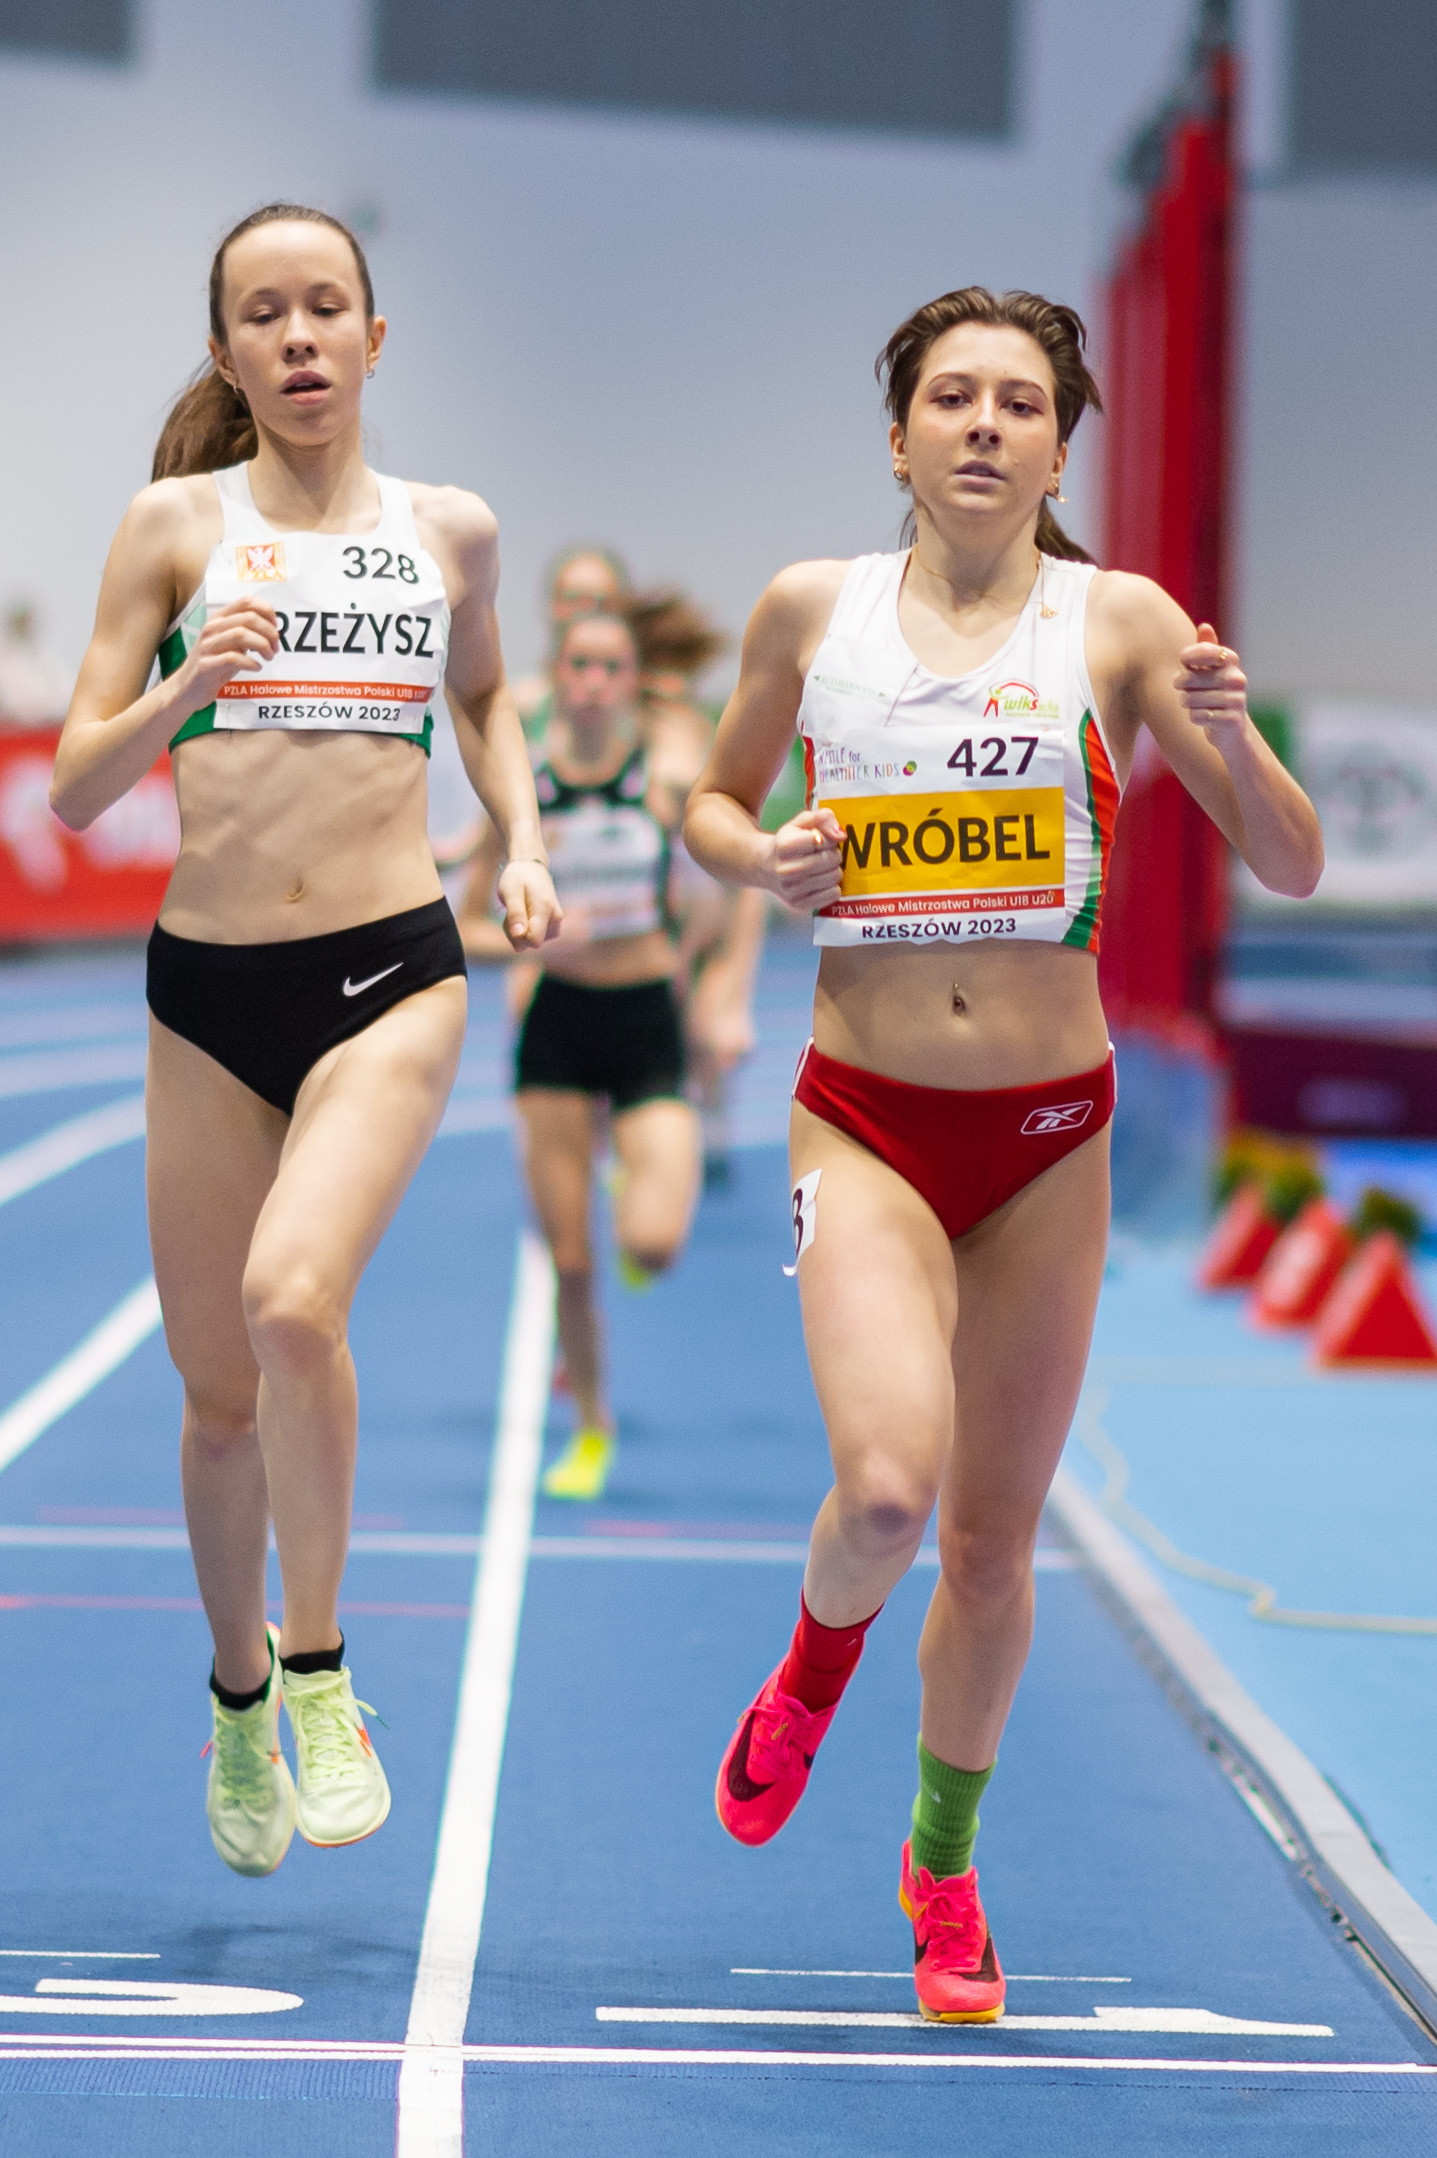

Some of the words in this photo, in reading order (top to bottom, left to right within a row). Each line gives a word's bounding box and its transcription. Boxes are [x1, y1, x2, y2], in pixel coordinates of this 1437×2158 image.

[343, 546, 419, 584] 328
[250, 603, 434, 658] RZEŻYSZ
[223, 685, 248, 696] PZLA
[249, 685, 293, 696] Halowe
[294, 685, 362, 697] Mistrzostwa
[363, 686, 396, 698] Polski
[258, 702, 353, 720] RZESZÓW
[358, 706, 401, 721] 2023
[946, 736, 1039, 777] 427
[874, 762, 900, 779] KIDS
[839, 808, 1051, 870] WRÓBEL
[855, 903, 896, 915] Halowe
[898, 898, 970, 912] Mistrzostwa
[973, 895, 1008, 909] Polski
[1009, 894, 1029, 907] U18
[862, 917, 962, 939] RZESZÓW
[967, 917, 1017, 935] 2023
